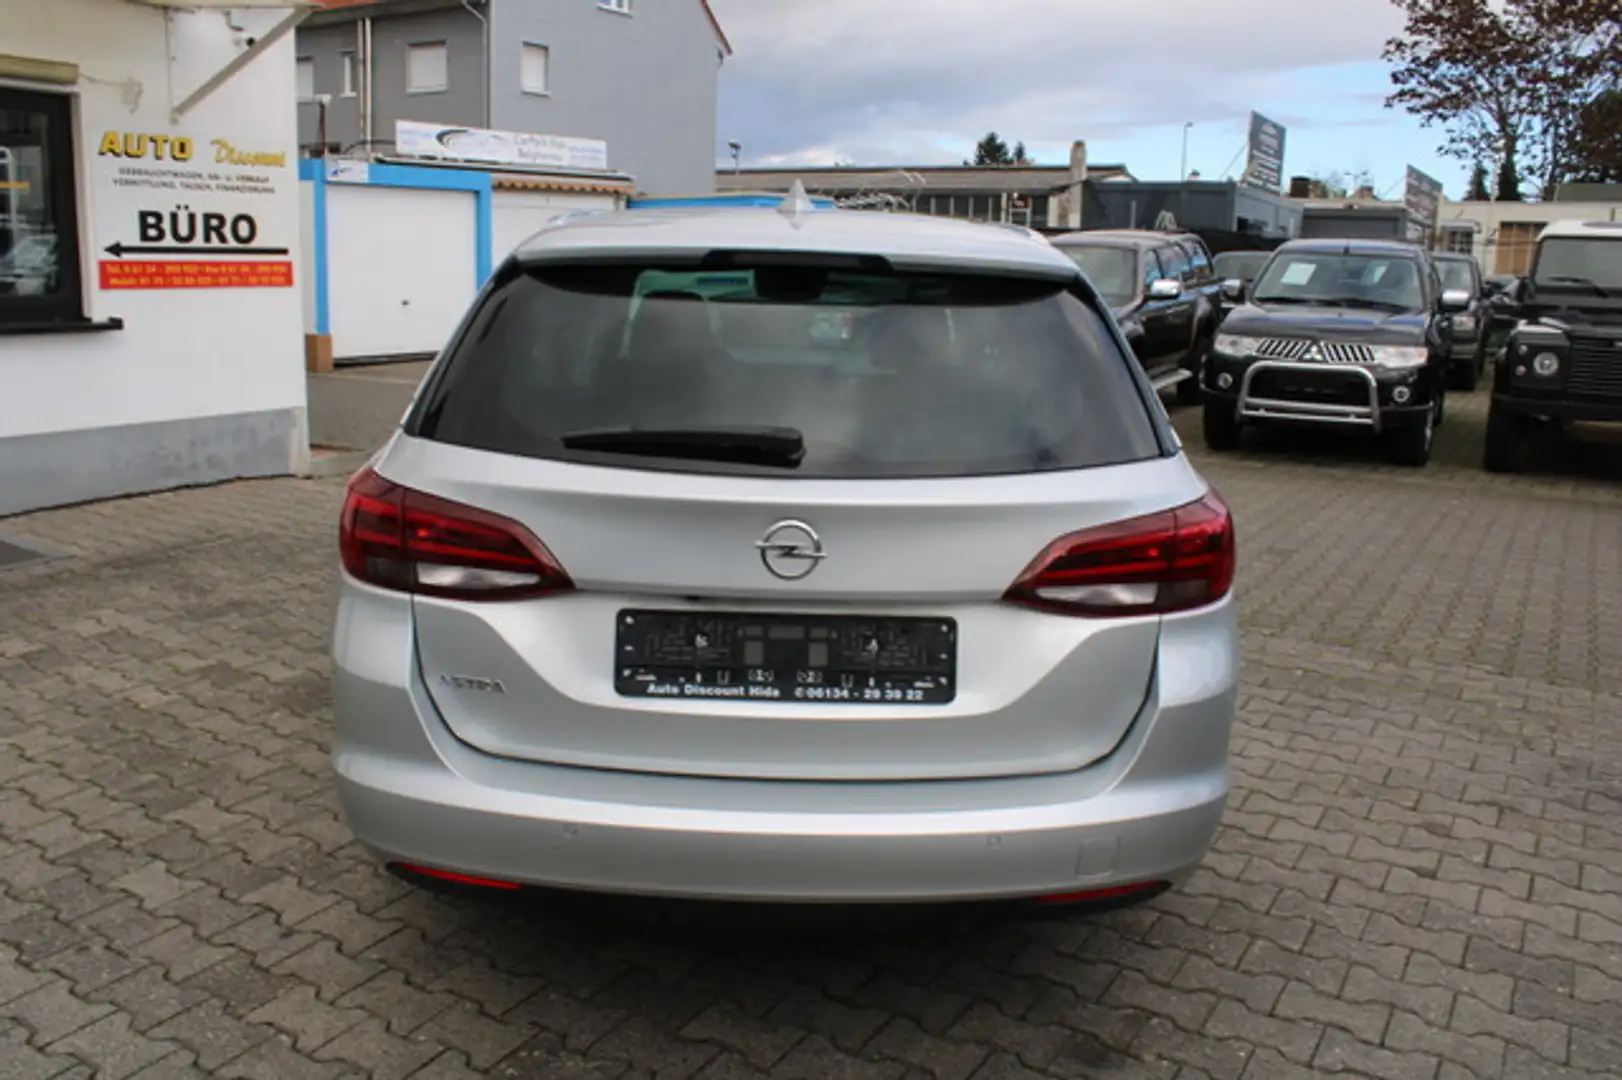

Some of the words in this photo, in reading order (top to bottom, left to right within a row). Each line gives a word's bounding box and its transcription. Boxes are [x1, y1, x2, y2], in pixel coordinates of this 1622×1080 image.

[98, 131, 195, 160] AUTO
[138, 204, 257, 245] BÜRO
[646, 683, 680, 695] Auto
[685, 684, 747, 697] Discount
